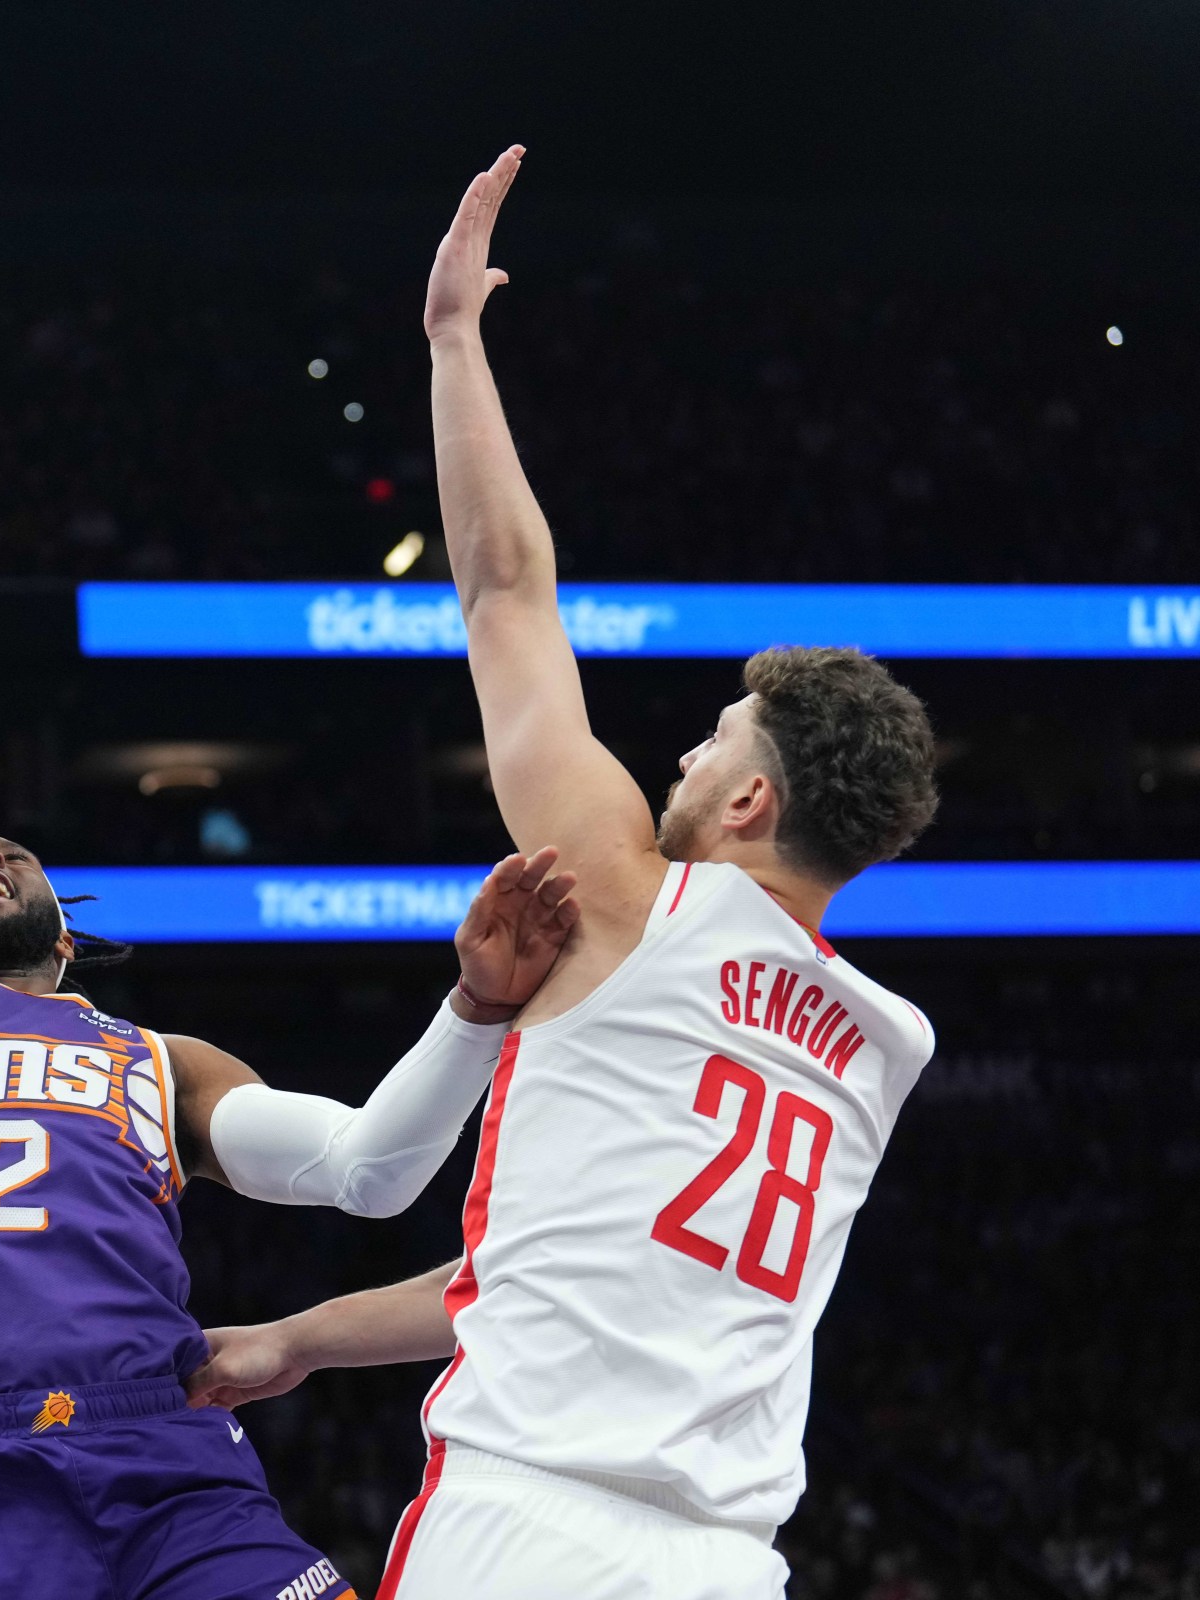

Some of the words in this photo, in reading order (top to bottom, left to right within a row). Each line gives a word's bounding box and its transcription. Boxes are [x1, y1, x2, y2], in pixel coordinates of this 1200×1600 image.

[306, 589, 650, 650] ticketter
[719, 959, 865, 1081] SENGUN
[650, 1054, 834, 1304] 28
